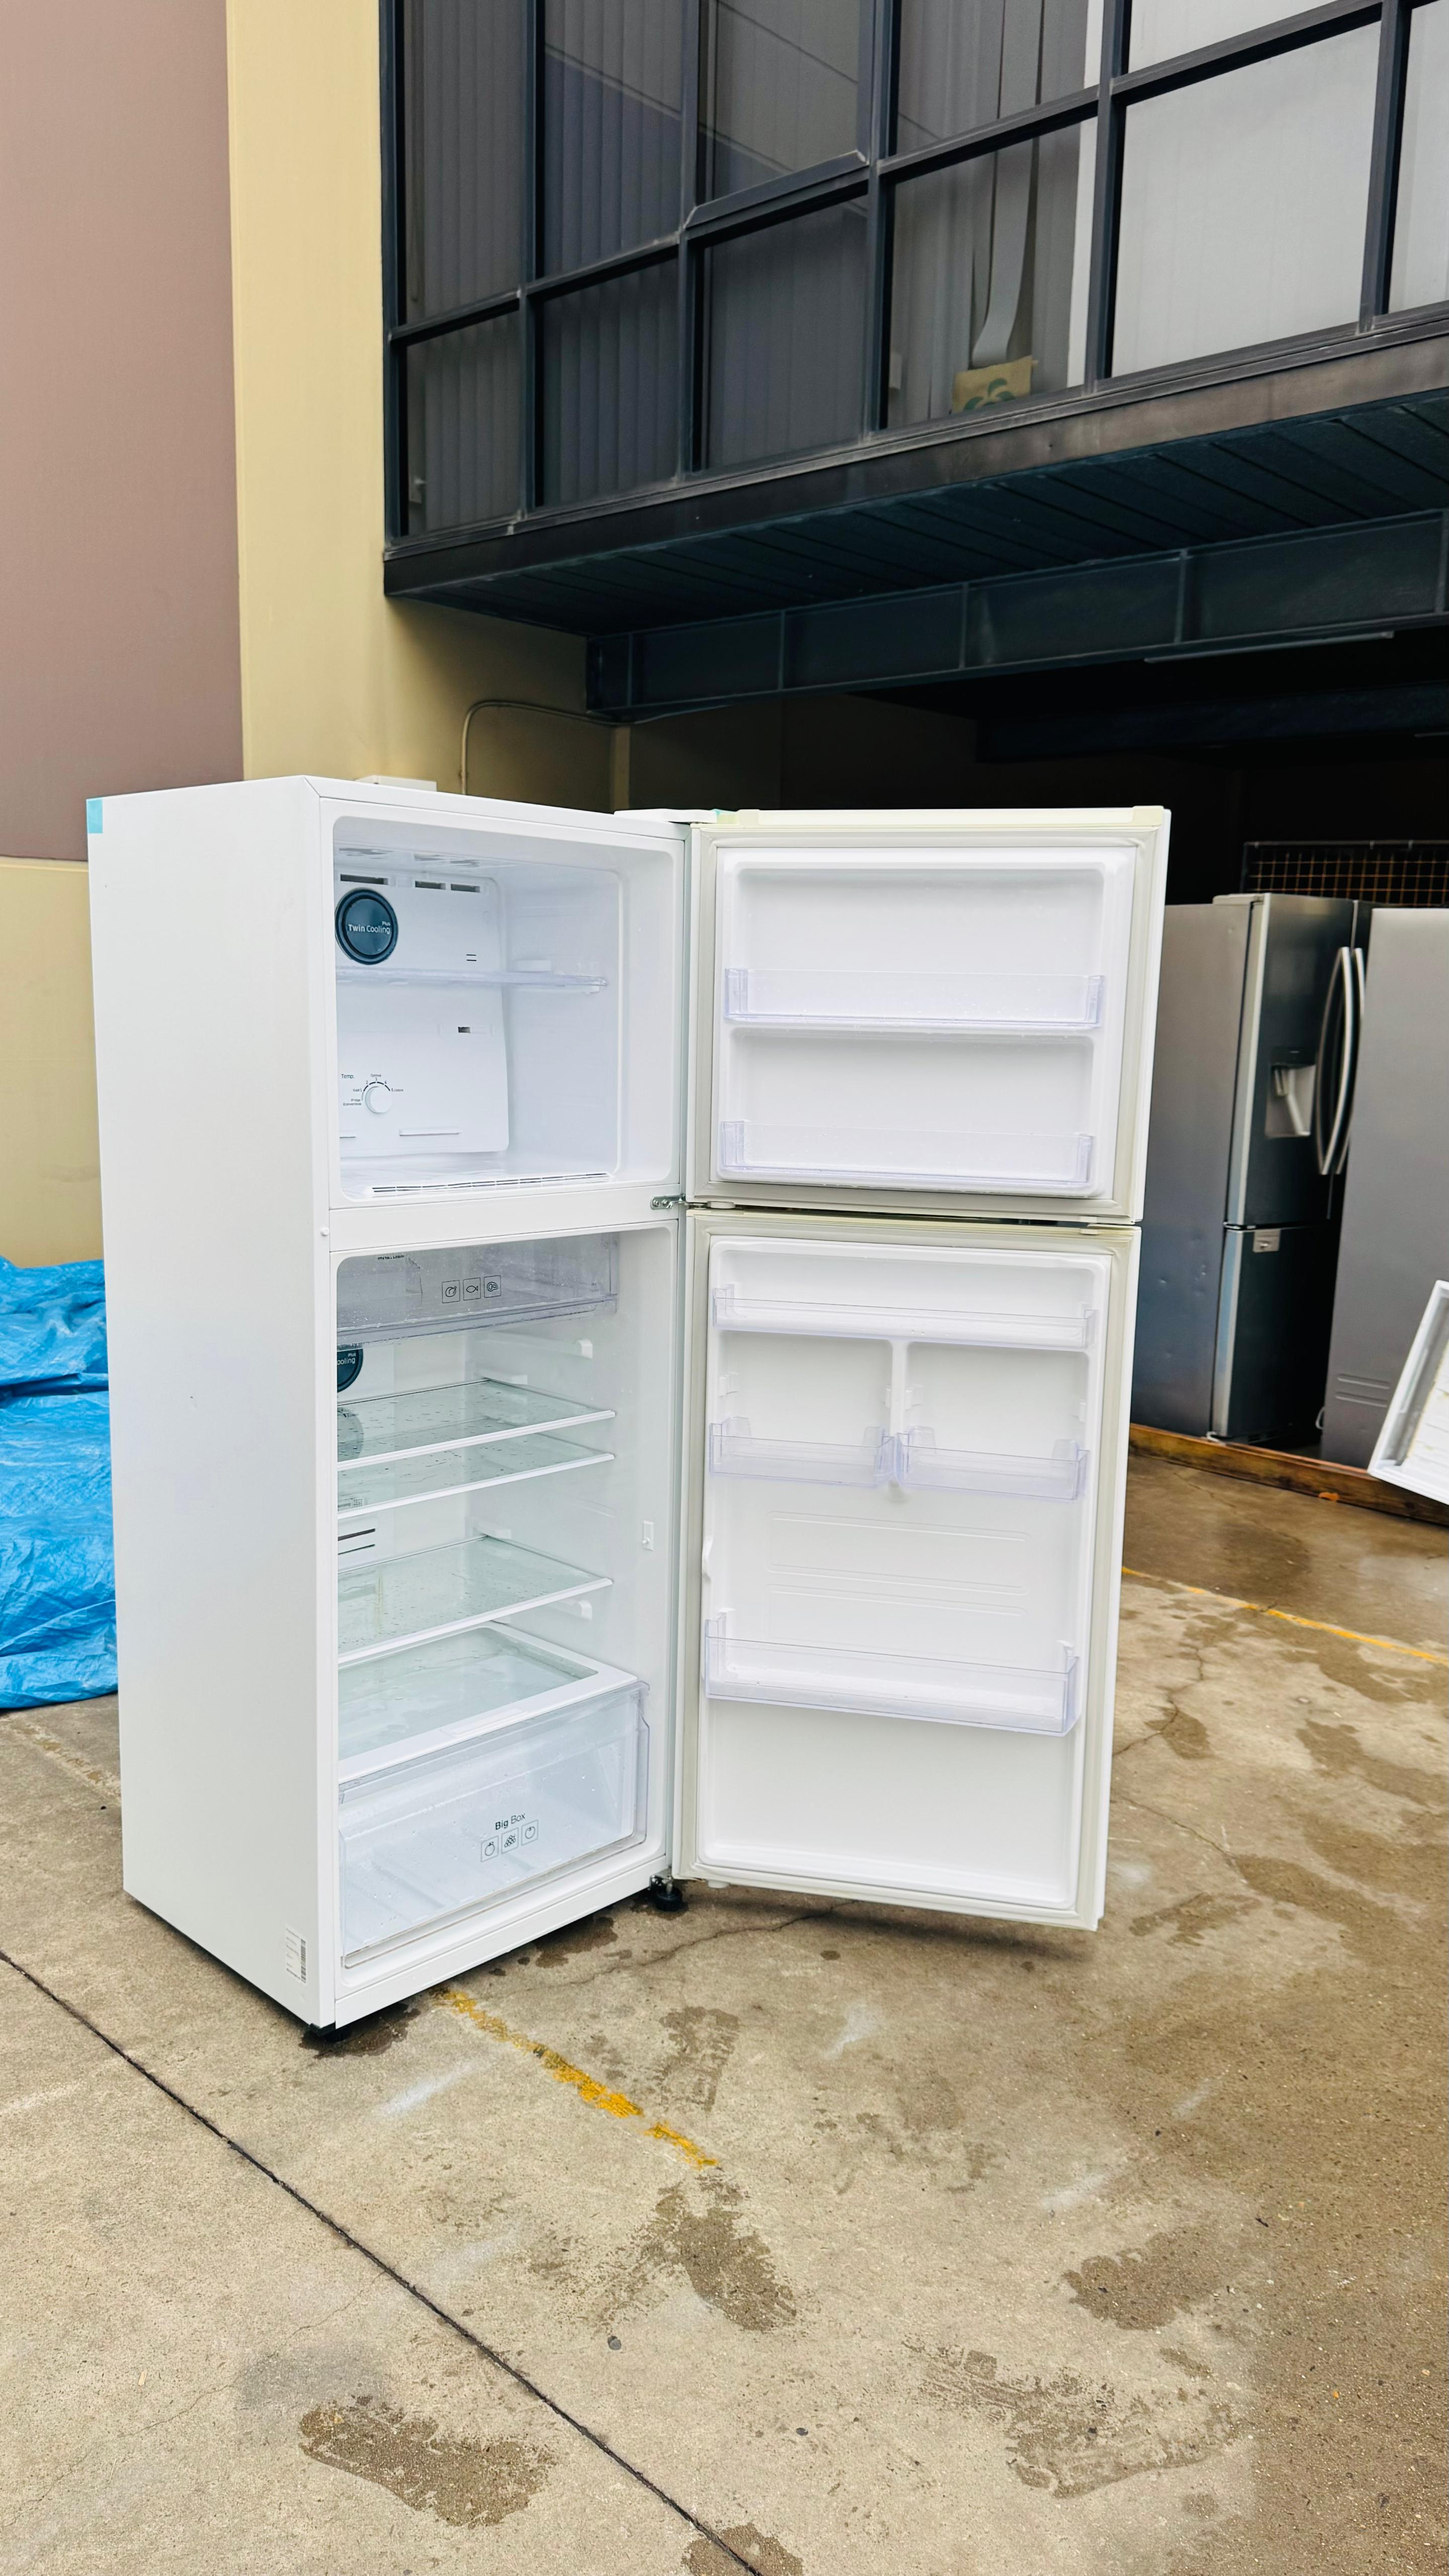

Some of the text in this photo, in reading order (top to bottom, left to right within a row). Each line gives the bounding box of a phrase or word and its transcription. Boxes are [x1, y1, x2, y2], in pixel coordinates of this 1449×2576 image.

[348, 924, 390, 935] Twin Cooling
[495, 1813, 525, 1830] Big Box
